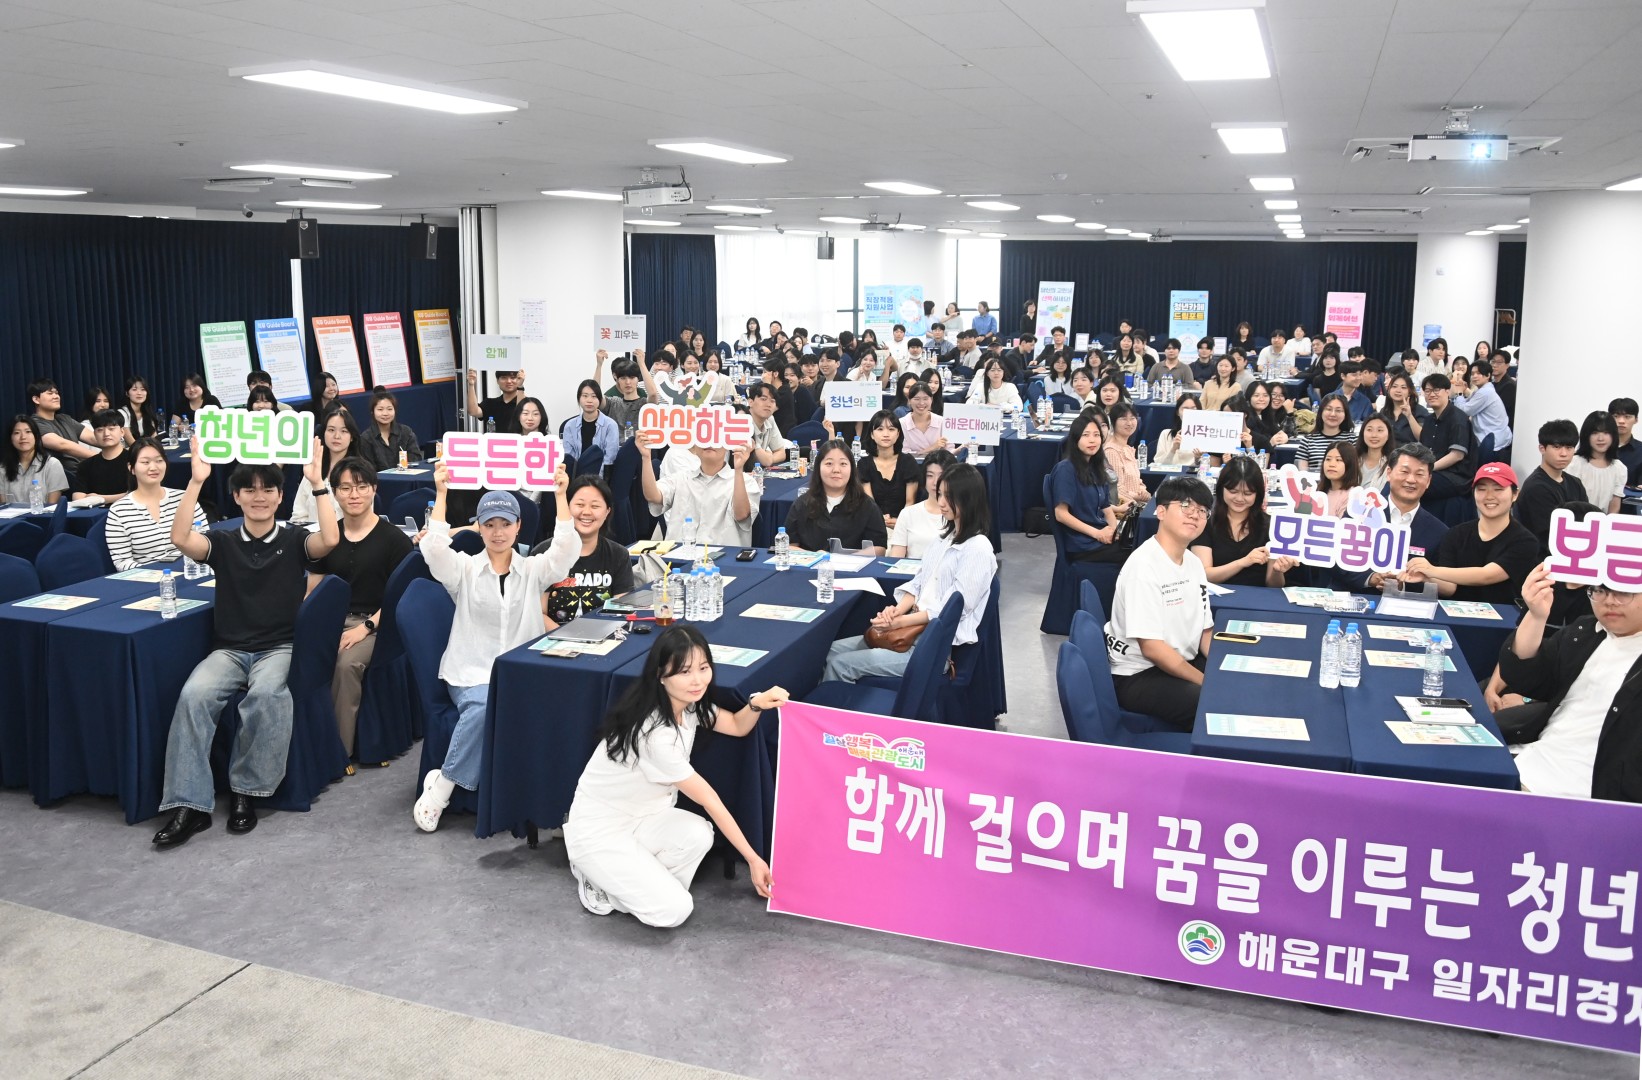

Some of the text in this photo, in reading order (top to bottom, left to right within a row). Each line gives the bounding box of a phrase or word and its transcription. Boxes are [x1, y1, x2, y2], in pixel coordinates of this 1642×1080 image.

[865, 296, 894, 304] 직장적응
[865, 303, 894, 311] 지원사업
[1173, 302, 1205, 311] 청년카페
[600, 327, 640, 340] 꽃 피우는
[485, 346, 508, 359] 함께
[830, 395, 878, 408] 청년의 꿈
[642, 407, 750, 446] 상상하는
[944, 417, 999, 432] 해운대에서
[1184, 424, 1239, 439] 시작합니다
[199, 410, 310, 460] 청년의
[445, 437, 560, 486] 든든한
[844, 765, 1640, 963] 함께 걸으며 꿈을 이루는 청년
[1237, 930, 1411, 991] 해운대구
